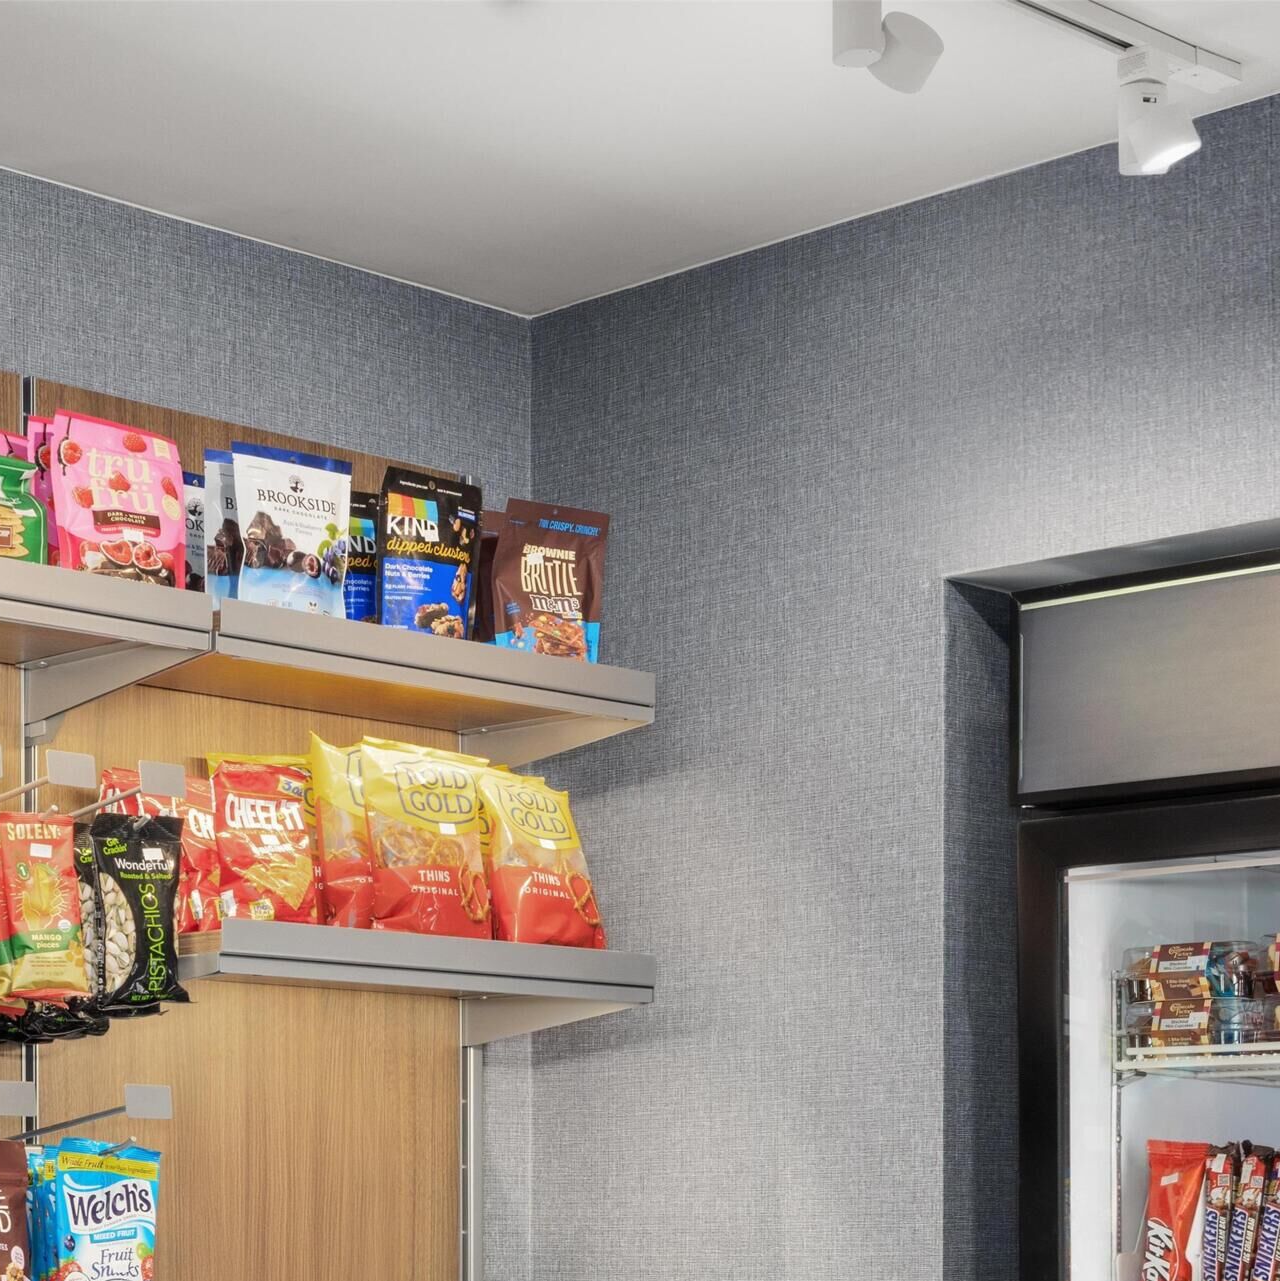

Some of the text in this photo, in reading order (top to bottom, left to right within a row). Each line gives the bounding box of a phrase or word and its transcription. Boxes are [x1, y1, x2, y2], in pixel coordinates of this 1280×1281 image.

[257, 488, 337, 515] BROOKSIDE
[387, 514, 439, 542] KIND
[387, 536, 432, 557] dipped
[524, 543, 576, 559] BROWNIE
[521, 556, 582, 596] BRITTLE
[404, 762, 468, 789] ROLD
[224, 793, 305, 830] CHEEZ-IT
[409, 792, 472, 814] GOLD
[8, 823, 57, 840] SOLELY
[115, 859, 174, 871] Wonderful
[419, 871, 450, 883] THINS
[140, 883, 166, 991] PISTACHIOS
[68, 1186, 152, 1225] Welch's
[94, 1230, 136, 1240] MIXED FRUIT
[101, 1249, 133, 1264] Fruit
